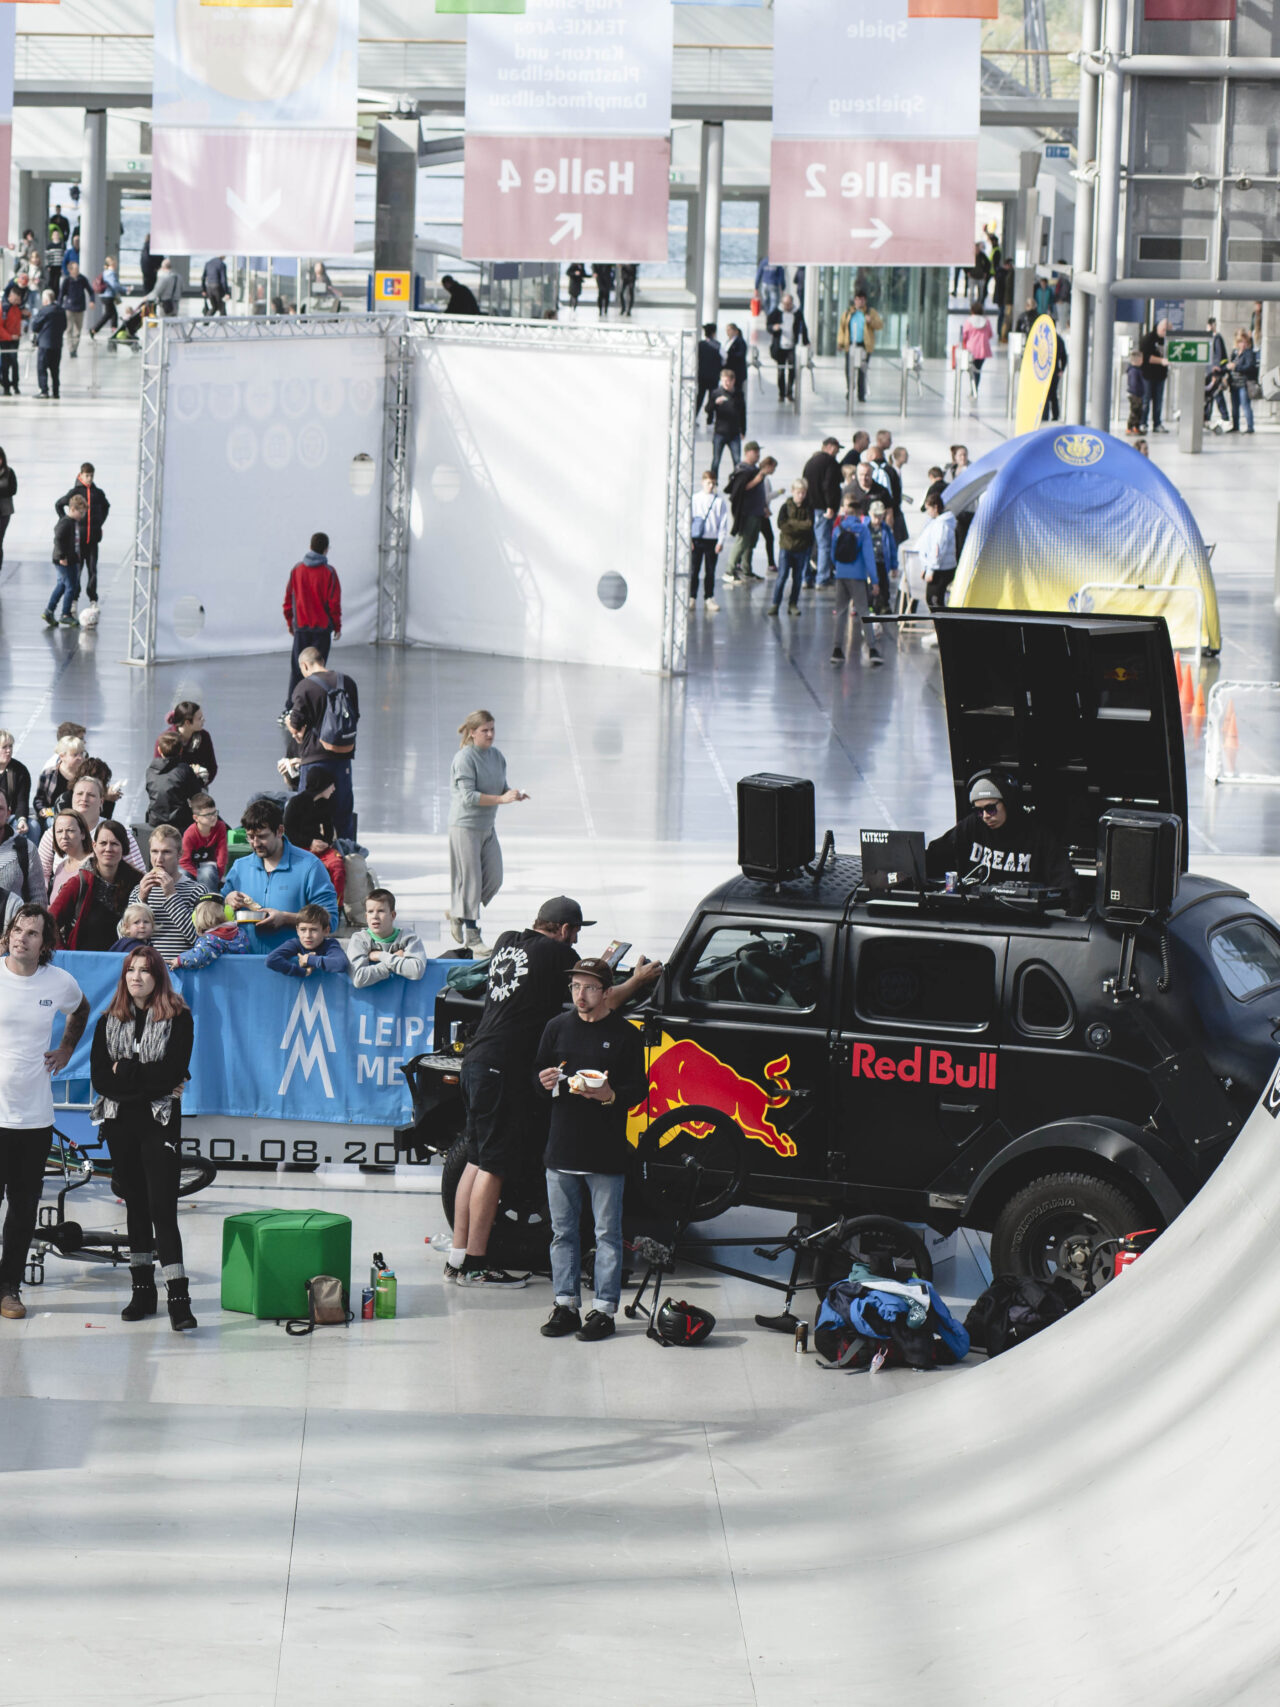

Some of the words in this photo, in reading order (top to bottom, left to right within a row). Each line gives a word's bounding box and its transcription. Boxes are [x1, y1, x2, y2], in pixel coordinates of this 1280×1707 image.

[861, 831, 889, 844] KITKUT
[970, 841, 1032, 873] DREAM
[851, 1042, 922, 1083] Red
[928, 1049, 998, 1090] Bull
